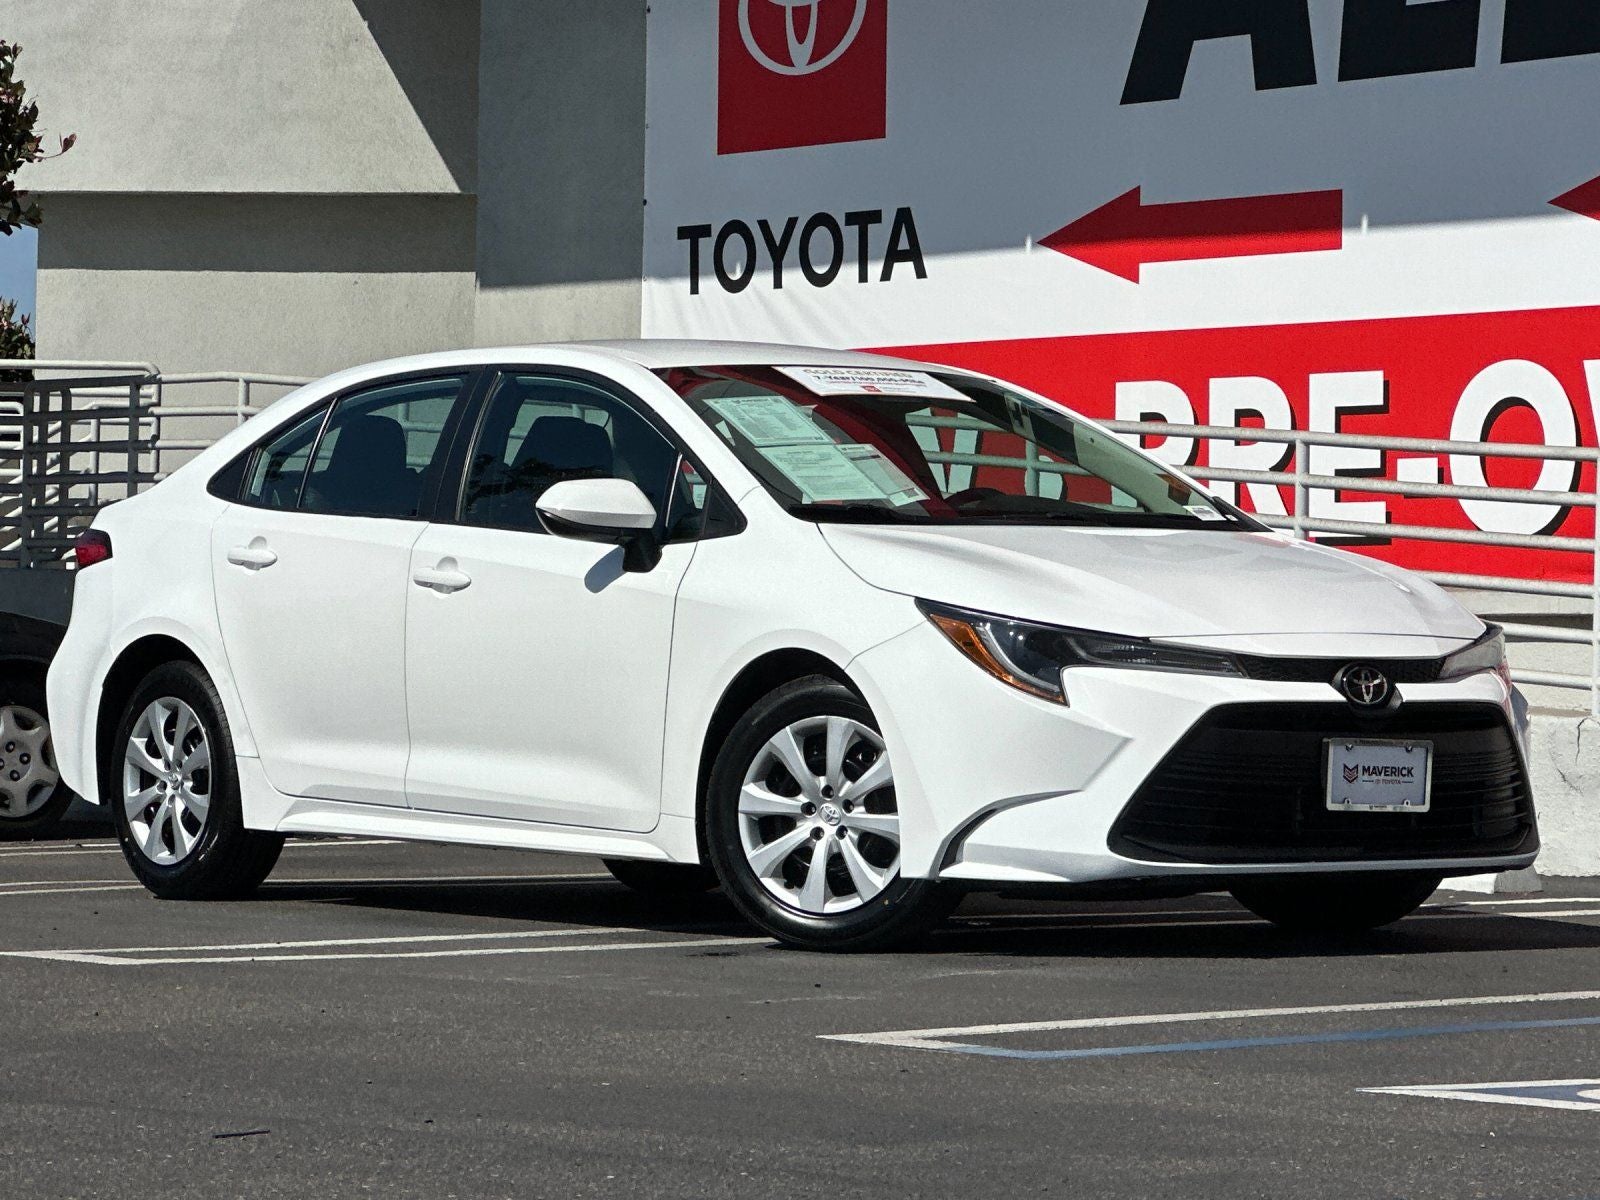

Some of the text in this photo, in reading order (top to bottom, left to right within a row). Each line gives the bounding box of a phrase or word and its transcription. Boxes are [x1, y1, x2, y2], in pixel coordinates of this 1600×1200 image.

[677, 206, 928, 296] TOYOTA
[1114, 358, 1600, 546] PRE-O
[1362, 765, 1414, 778] MAVERICK
